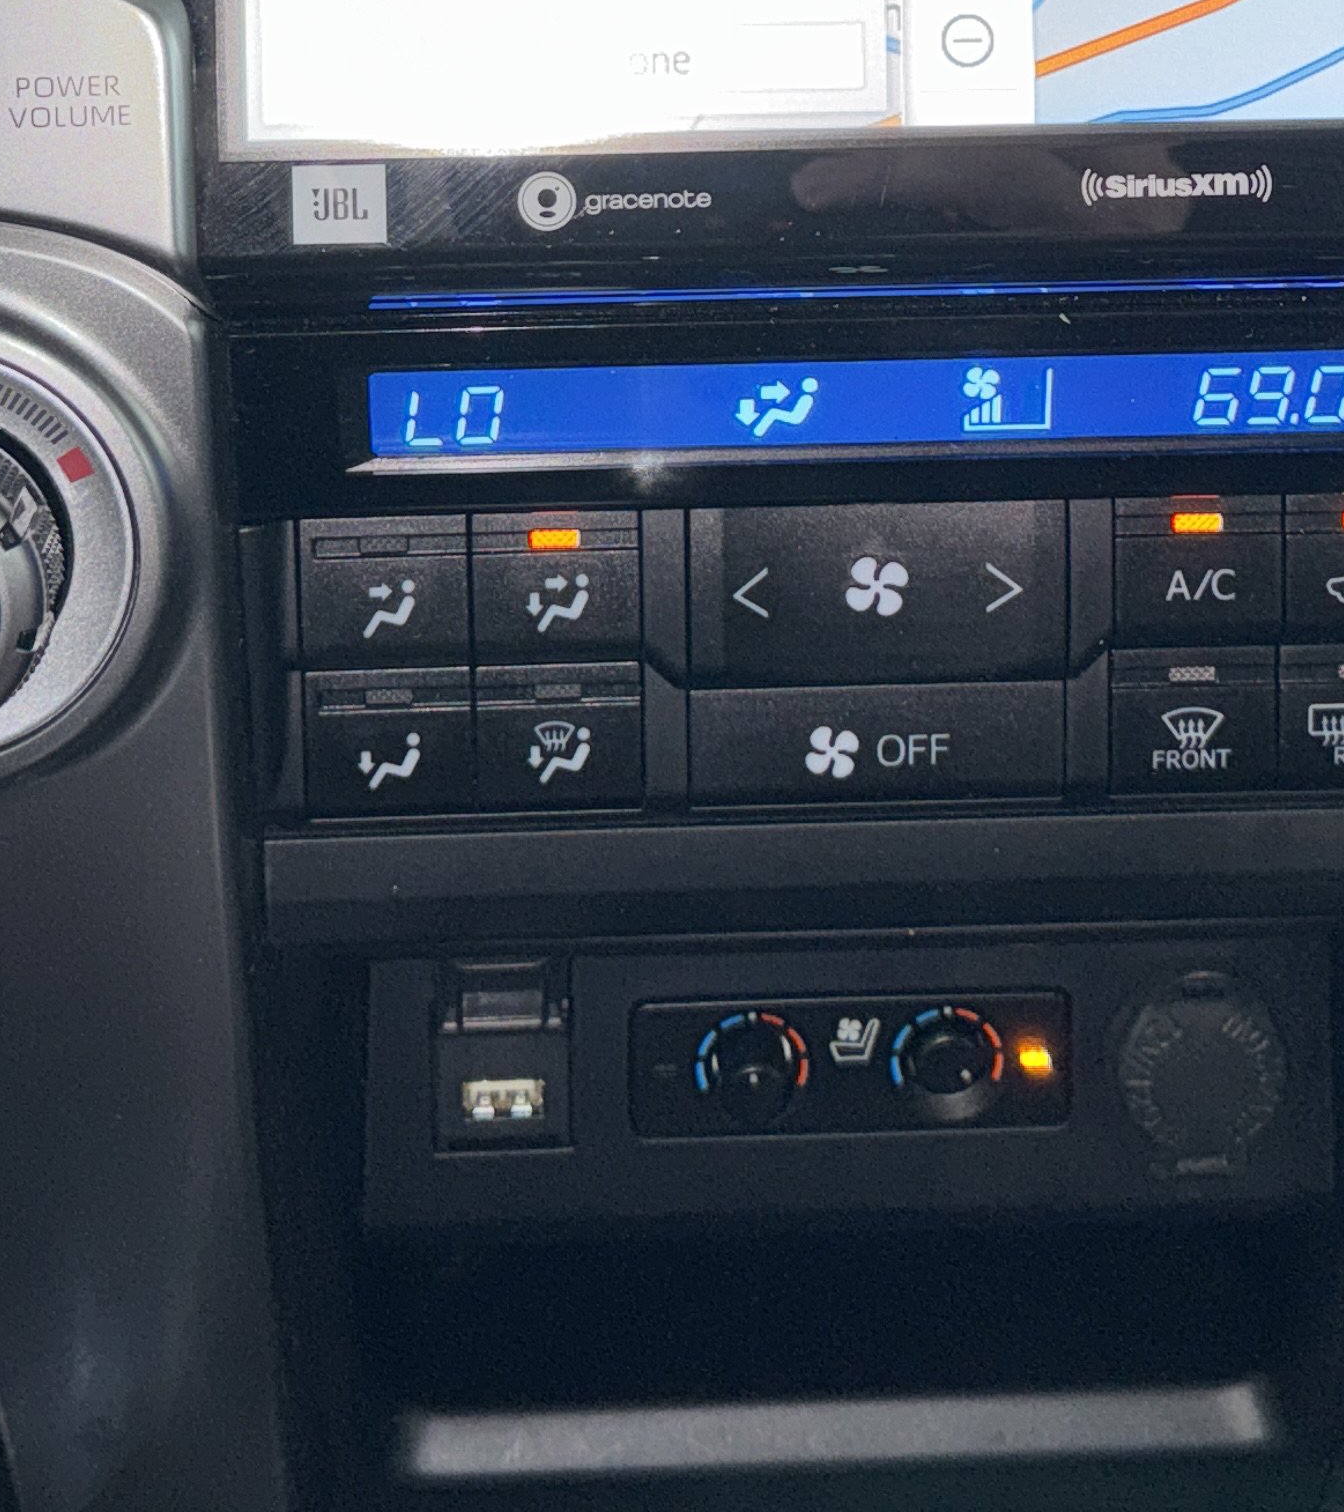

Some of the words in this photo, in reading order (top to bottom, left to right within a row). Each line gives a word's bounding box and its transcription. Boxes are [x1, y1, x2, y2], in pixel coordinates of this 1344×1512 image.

[15, 74, 122, 99] POWER
[8, 103, 133, 129] VOLUME
[313, 188, 370, 221] JBL
[584, 188, 713, 217] gracenote
[404, 384, 505, 447] LO
[1165, 567, 1237, 602] A/C
[875, 733, 950, 768] OFF
[1152, 747, 1233, 770] FRONT
